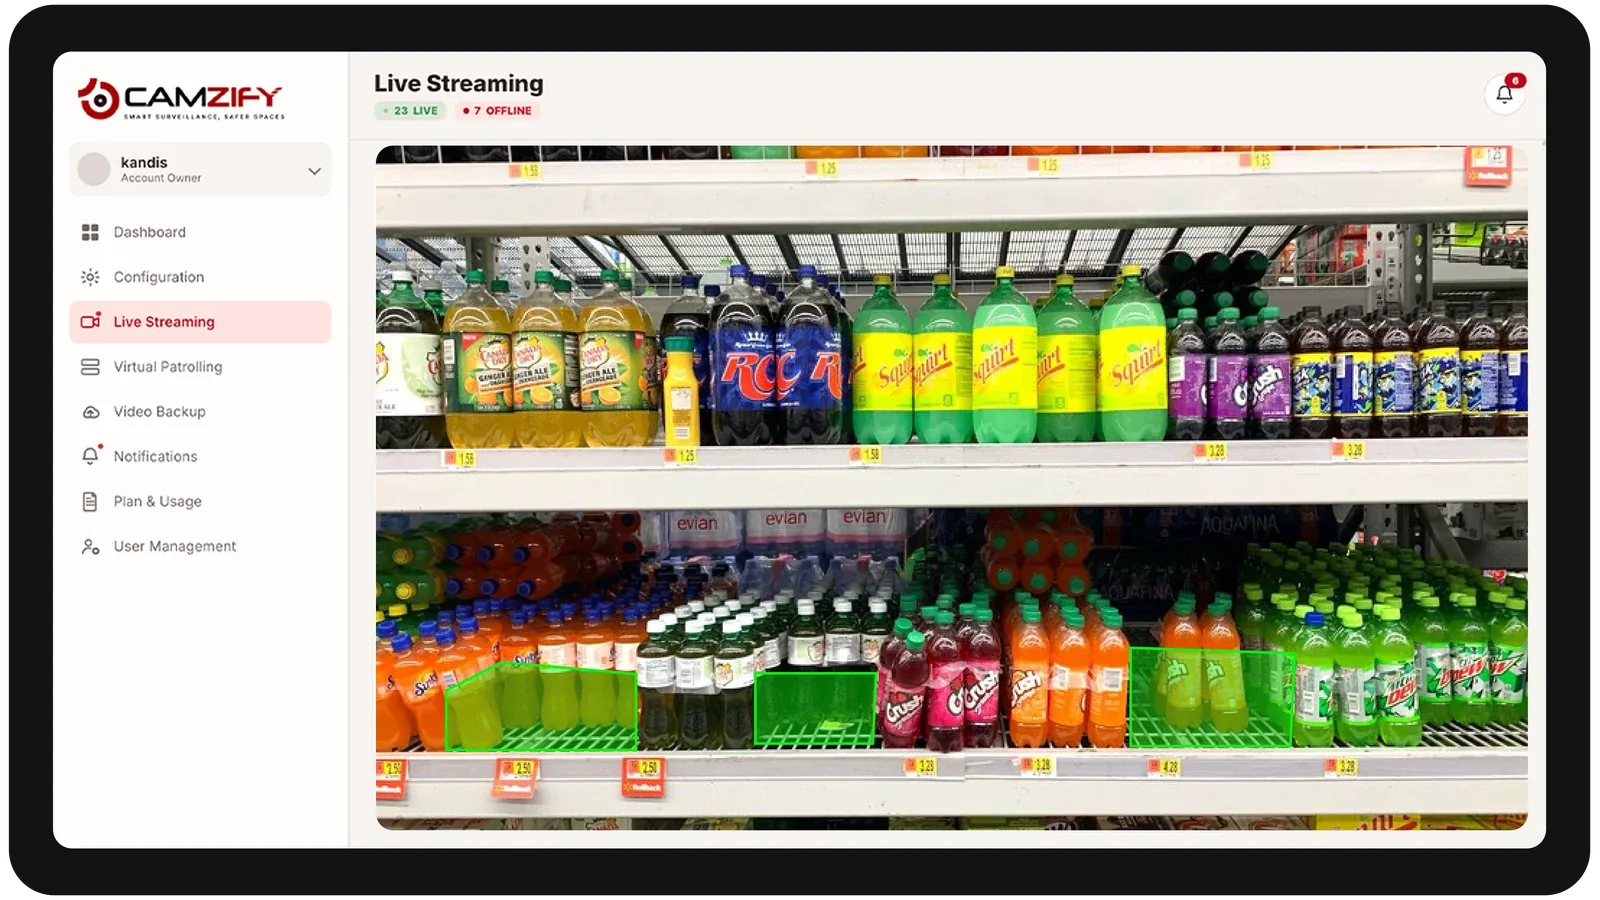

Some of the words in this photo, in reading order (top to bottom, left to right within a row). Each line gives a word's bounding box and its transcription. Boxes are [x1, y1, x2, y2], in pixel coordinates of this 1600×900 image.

[375, 73, 421, 92] Live
[427, 73, 544, 97] Streaming
[1511, 76, 1520, 86] 6
[125, 86, 283, 107] CAMZIFY
[155, 113, 221, 121] SURVEILLANCE,
[394, 105, 408, 116] 23
[413, 105, 438, 116] LIVE
[474, 105, 482, 116] 7
[486, 105, 532, 116] OFFLINE
[121, 156, 168, 169] kandis
[121, 172, 165, 183] Account
[167, 172, 202, 183] Owner
[114, 225, 186, 239] Dashboard
[114, 270, 205, 286] Configuration
[114, 315, 142, 328] Live
[146, 315, 215, 331] Streaming
[114, 359, 157, 373] Virtual
[161, 359, 223, 376] Patrolling
[114, 404, 153, 418] Video
[156, 404, 206, 421] Backup
[114, 449, 198, 463] Notifications
[114, 494, 142, 508] Plan
[146, 494, 156, 508] &
[159, 494, 203, 511] Usage
[678, 516, 718, 531] evian
[766, 511, 808, 526] evian
[843, 508, 887, 524] evian
[1200, 514, 1281, 535] AQUAFINA
[114, 540, 145, 553] User
[149, 540, 237, 556] Management
[516, 761, 532, 775] 2.50
[642, 761, 657, 774] 2.50
